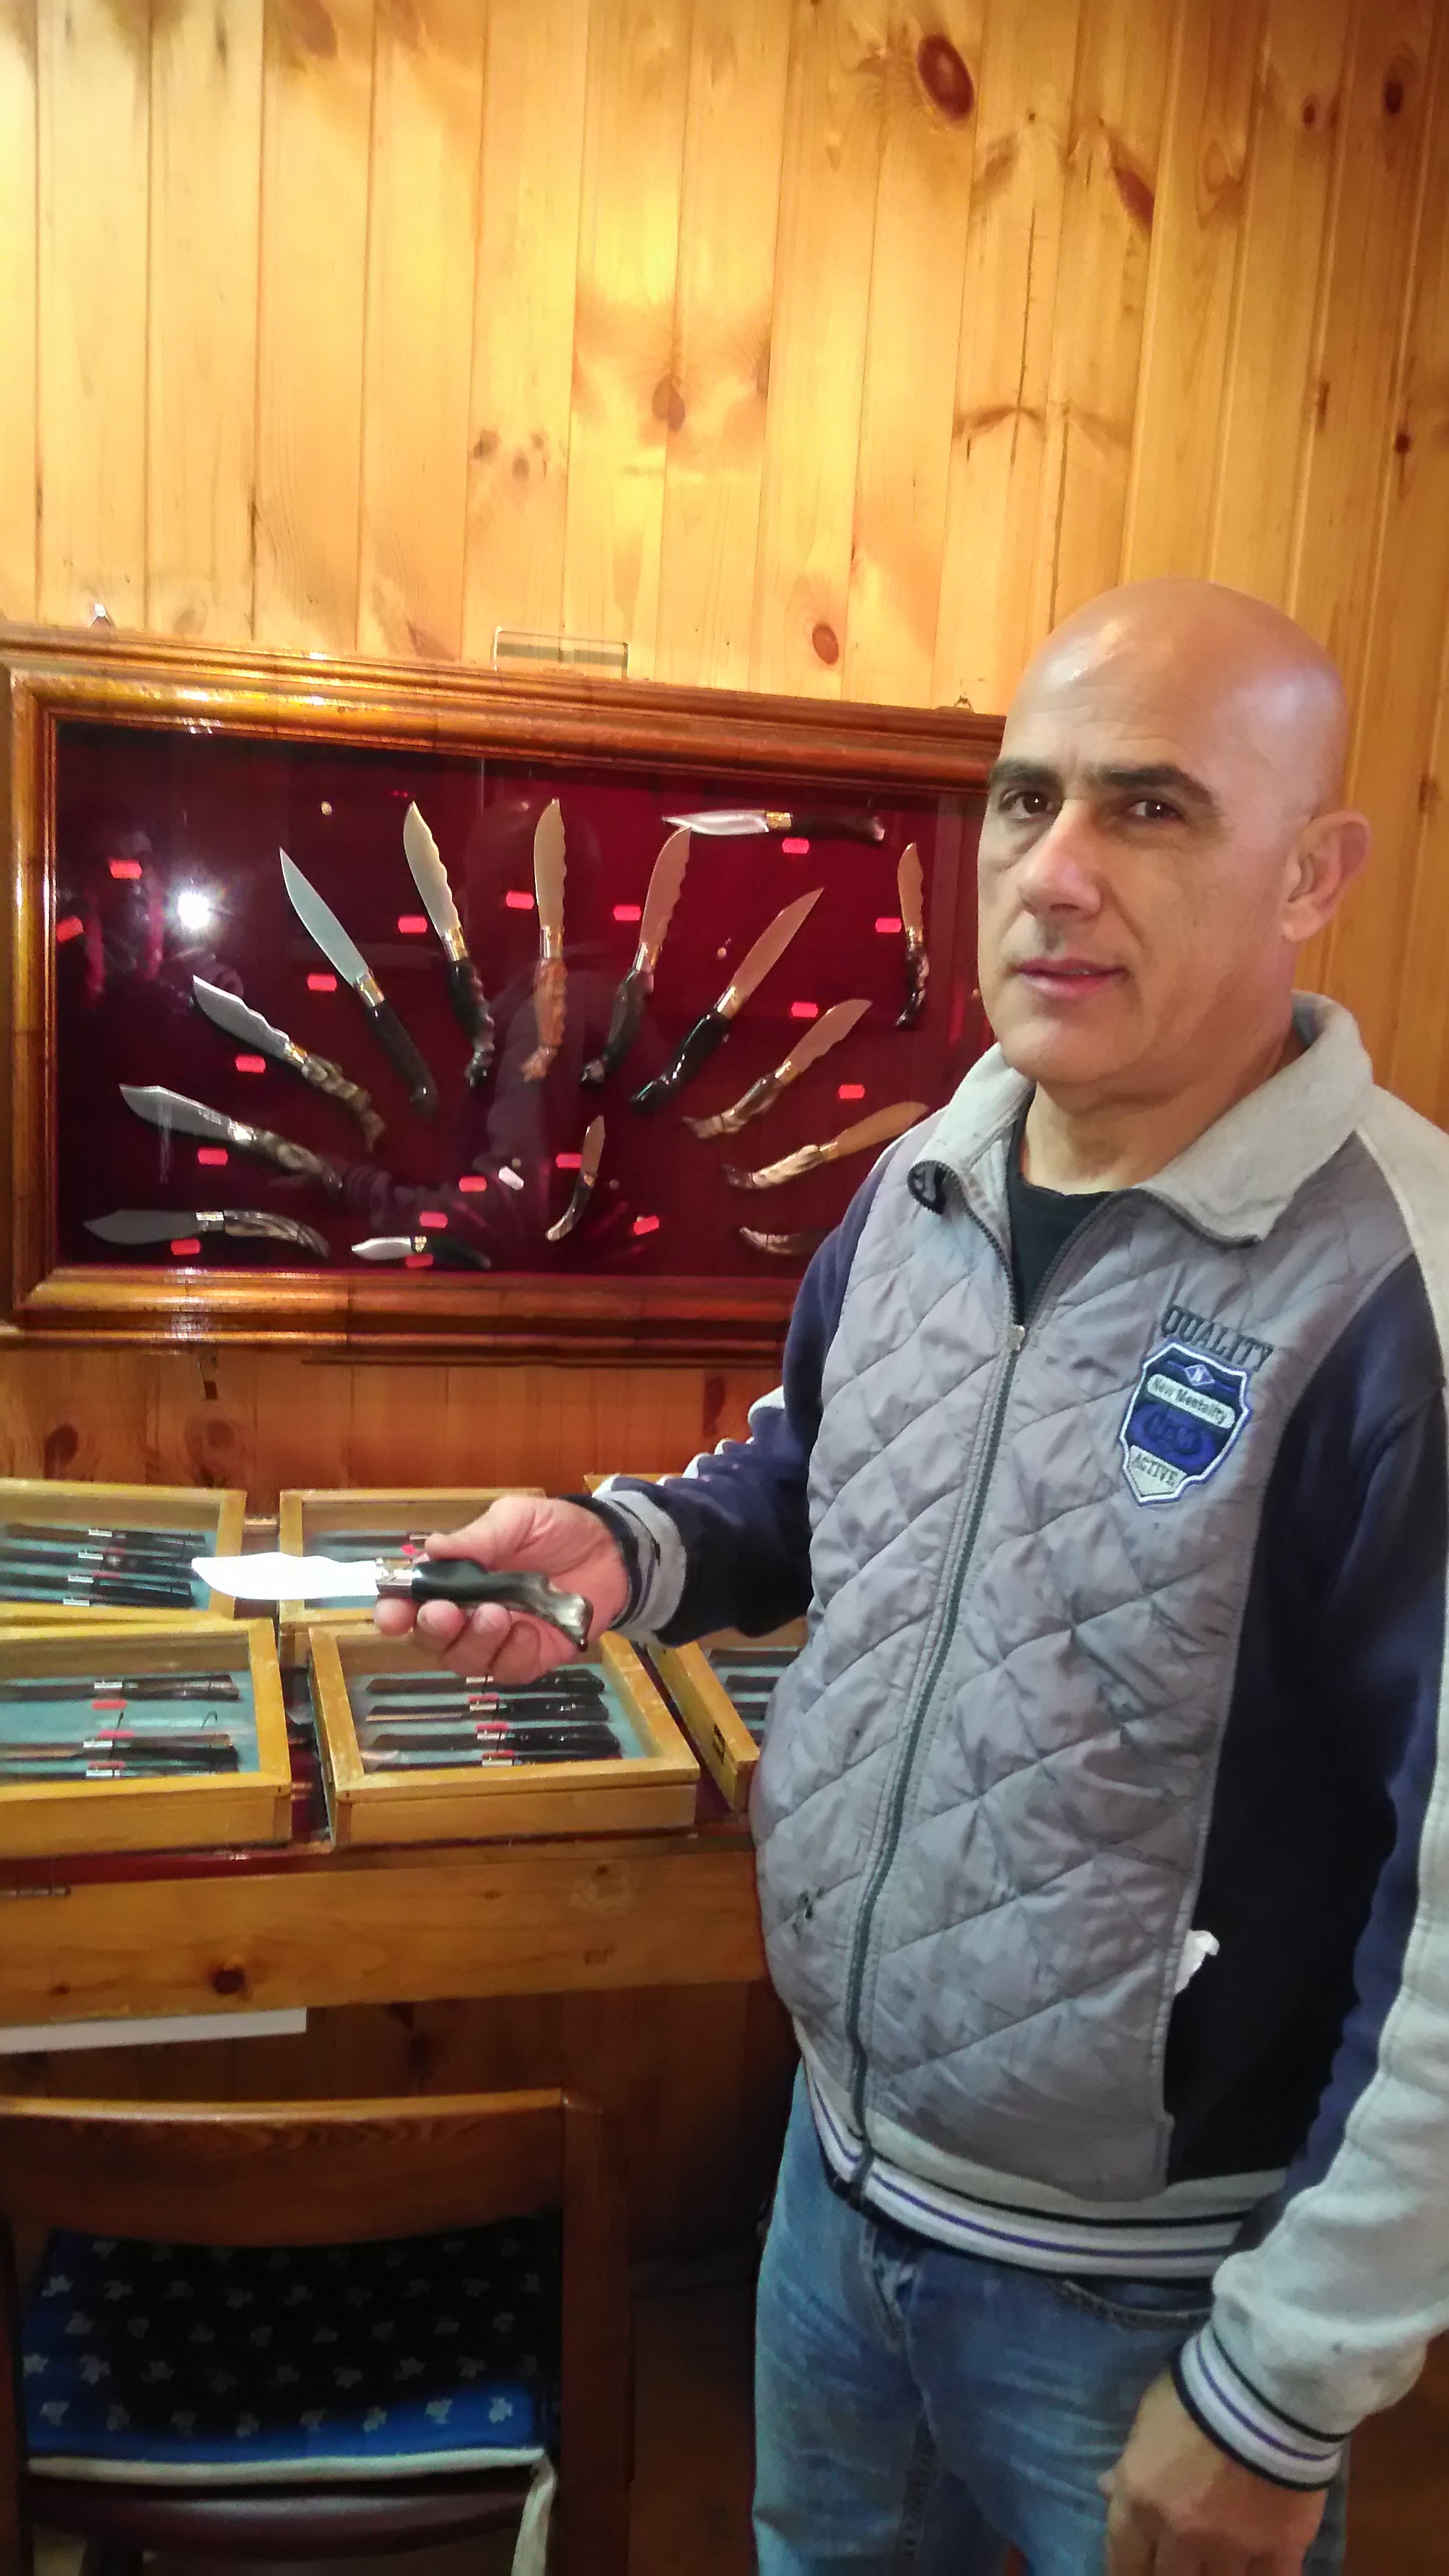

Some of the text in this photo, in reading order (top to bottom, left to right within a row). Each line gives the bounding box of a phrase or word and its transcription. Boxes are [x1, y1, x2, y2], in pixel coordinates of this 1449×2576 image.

[1160, 1304, 1274, 1373] QUALITY
[1152, 1377, 1227, 1425] New Mentality
[1131, 1453, 1178, 1487] ACTIVE
